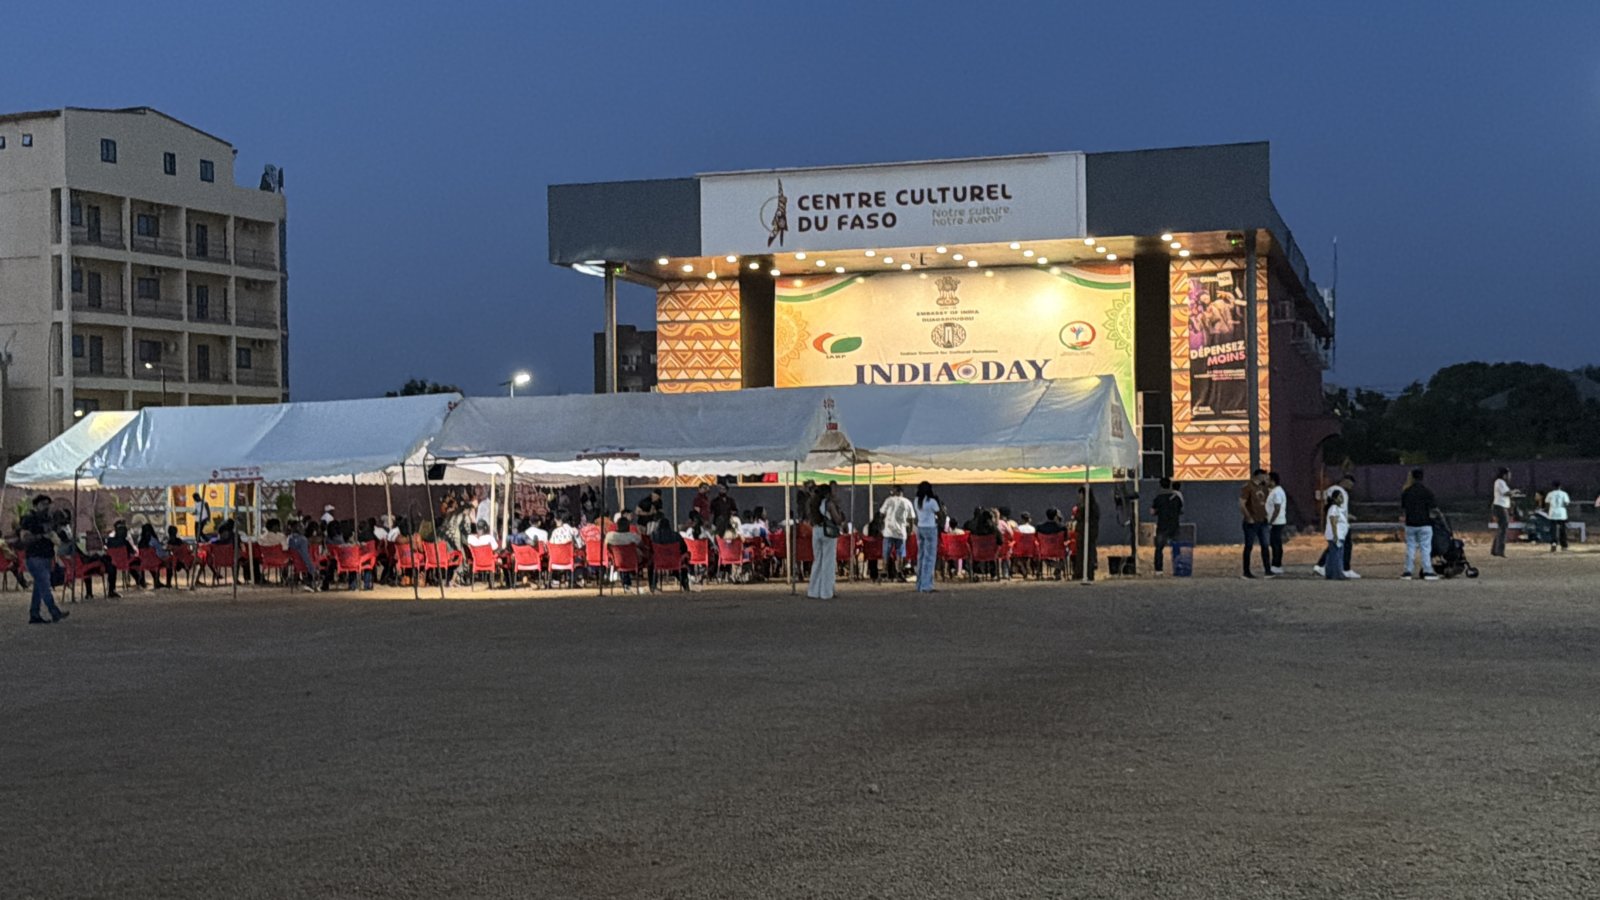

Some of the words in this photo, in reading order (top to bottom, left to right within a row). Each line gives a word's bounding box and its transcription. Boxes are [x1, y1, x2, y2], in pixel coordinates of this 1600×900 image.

[797, 191, 886, 211] CENTRE
[895, 184, 1013, 206] CULTUREL
[798, 215, 829, 232] DU
[837, 212, 897, 231] FASO
[932, 208, 965, 218] Notre
[932, 217, 964, 226] notre
[1190, 340, 1246, 360] DÉPENSEZ
[1207, 350, 1246, 366] MOINS
[854, 361, 957, 384] INDIA
[979, 359, 1053, 381] DAY
